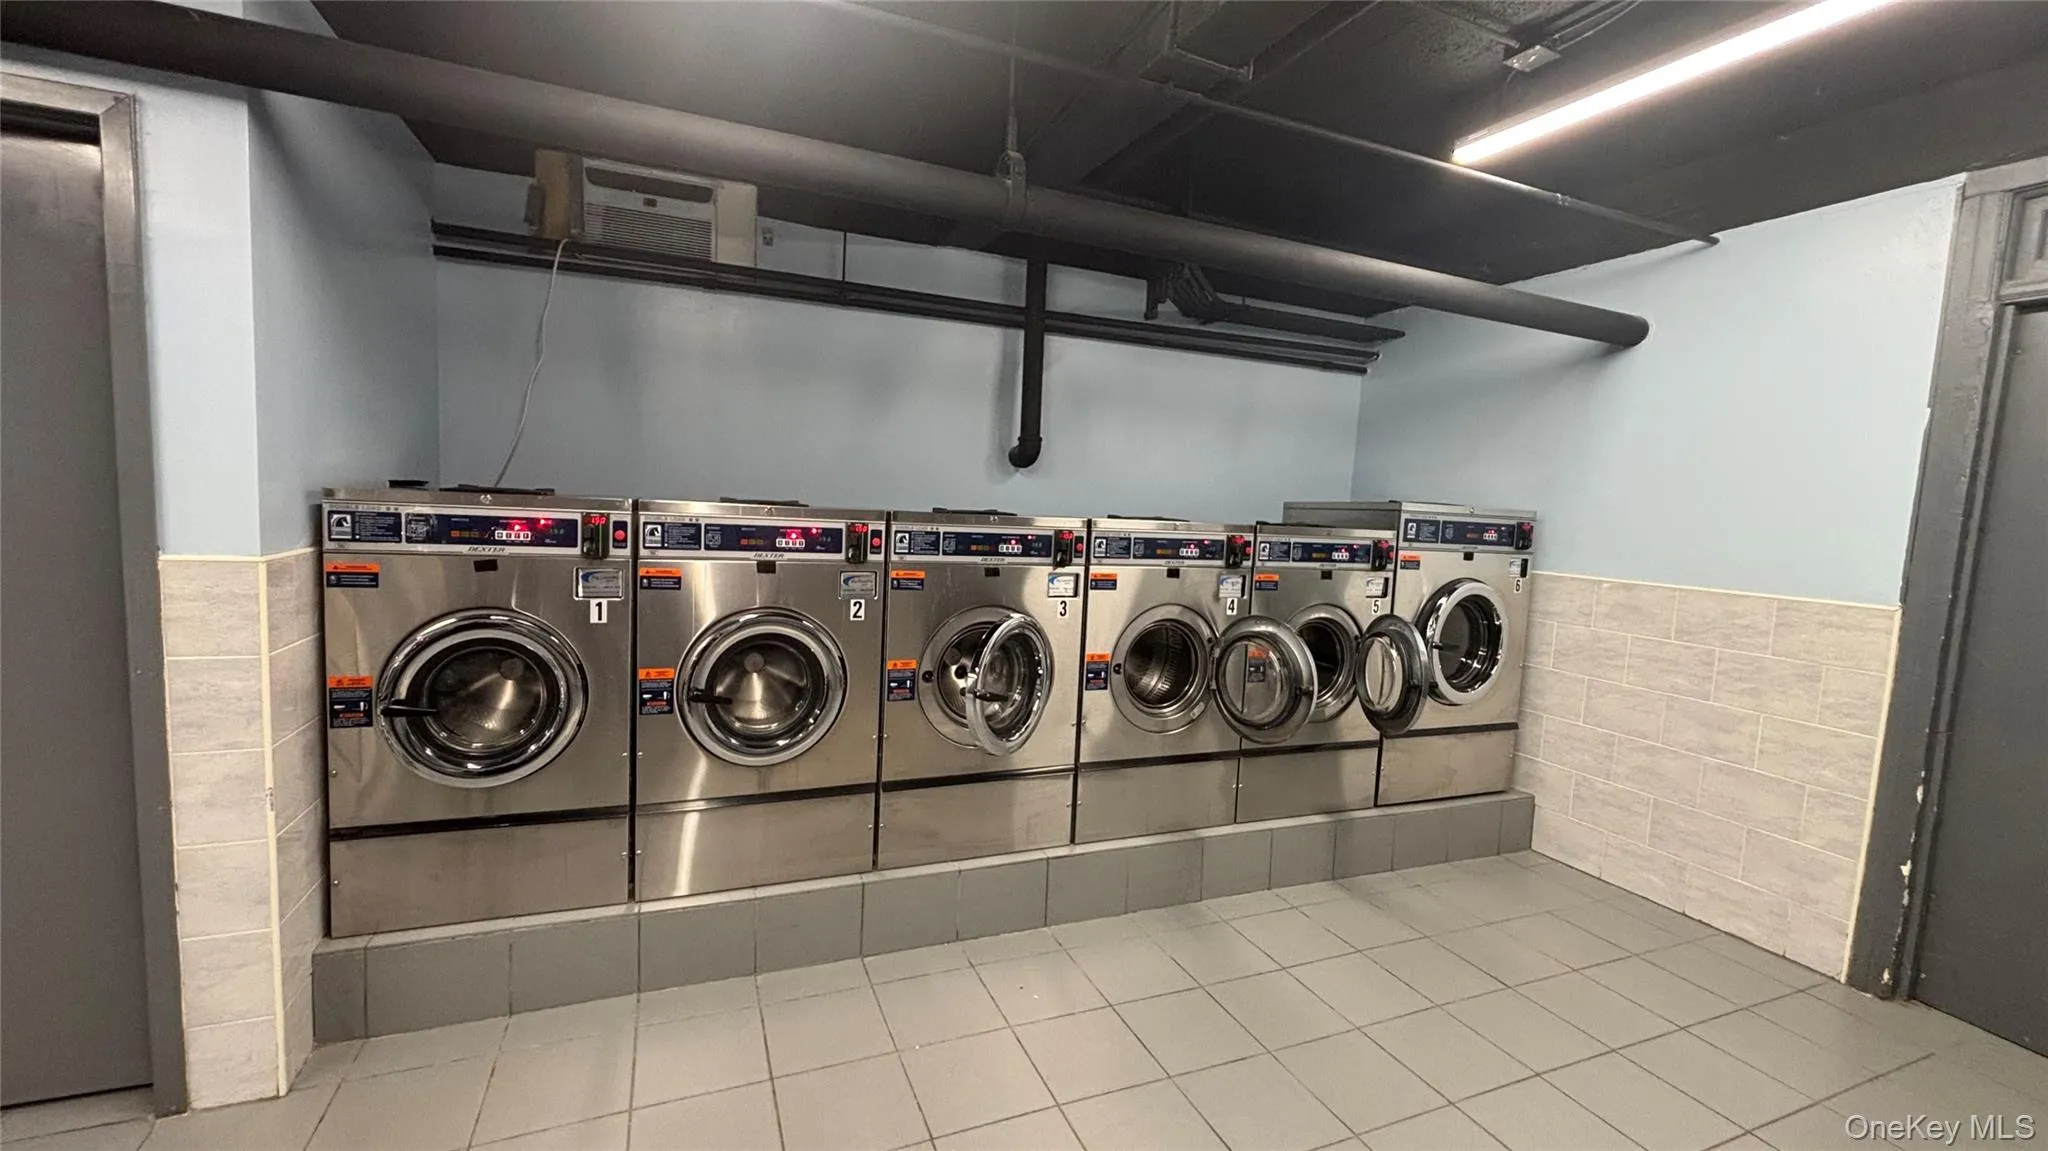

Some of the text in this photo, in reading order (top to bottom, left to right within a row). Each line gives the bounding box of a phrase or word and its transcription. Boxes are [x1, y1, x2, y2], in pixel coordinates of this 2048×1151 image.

[1515, 579, 1521, 592] 6
[595, 601, 602, 621] 1
[853, 600, 863, 619] 2
[1059, 600, 1067, 616] 3
[1228, 599, 1235, 613] 4
[1373, 599, 1380, 613] 5
